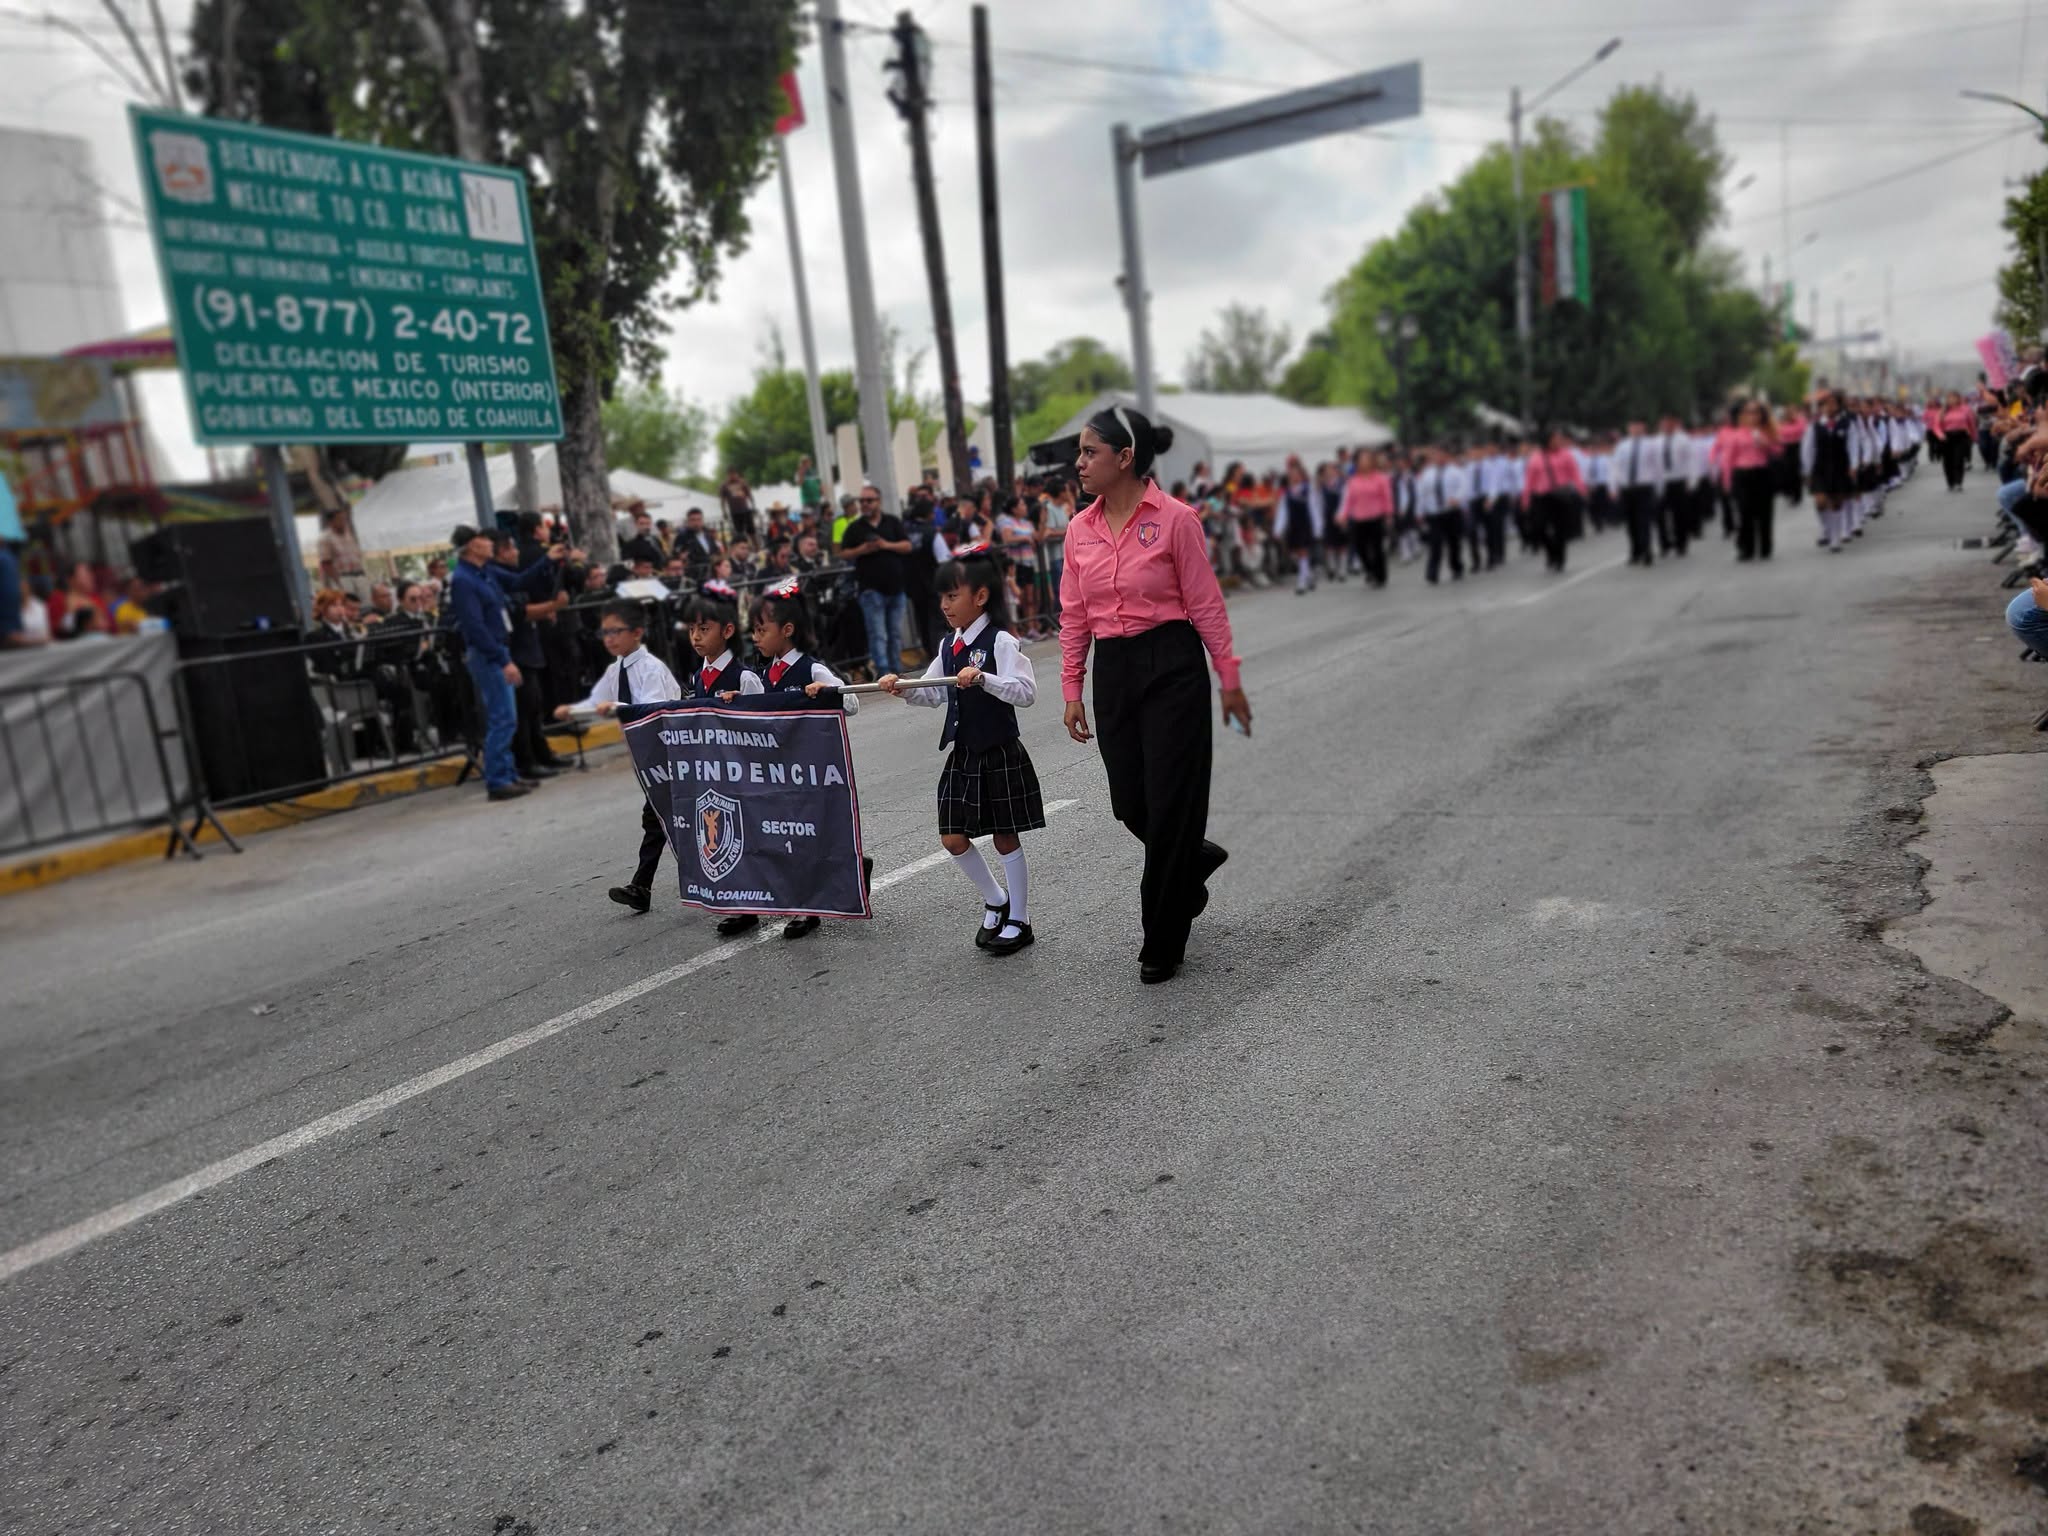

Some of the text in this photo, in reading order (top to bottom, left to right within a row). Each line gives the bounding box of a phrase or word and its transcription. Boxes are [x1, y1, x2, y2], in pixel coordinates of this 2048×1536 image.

[349, 160, 363, 187] A
[227, 181, 323, 221] WELCOME
[331, 194, 356, 225] TO
[404, 200, 461, 236] ACUÑA
[193, 285, 533, 345] (91-877) 2-40-72
[216, 343, 530, 375] DELEGACION DE TURISMO
[195, 374, 552, 404] PUERTA DE MEXICO (INTERIOR)
[204, 406, 554, 429] GOBIERNO DEL ESTADO DE COAHUILA
[705, 729, 779, 748] PRIMARIA
[762, 820, 816, 837] SECTOR
[785, 840, 793, 854] 1
[687, 884, 699, 895] CD.
[716, 890, 775, 902] COAHUILA.
